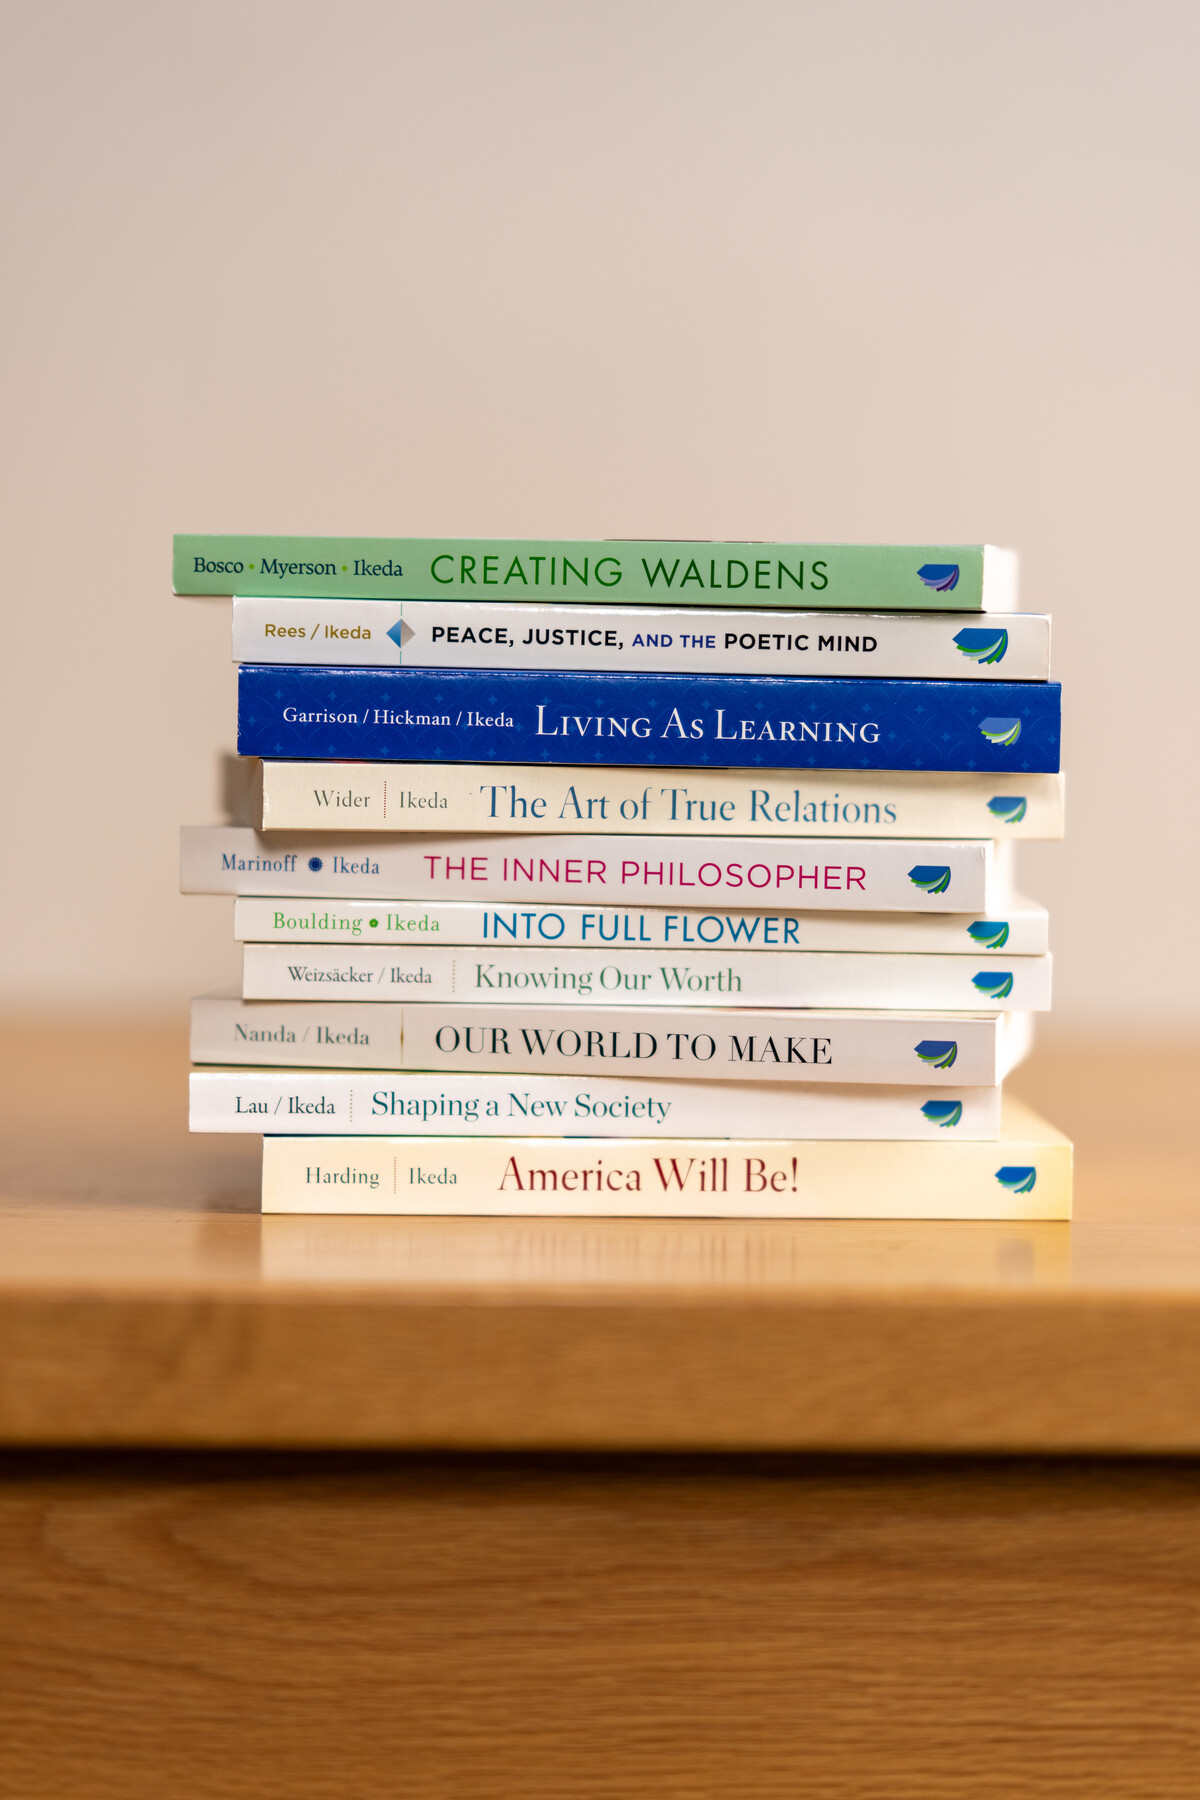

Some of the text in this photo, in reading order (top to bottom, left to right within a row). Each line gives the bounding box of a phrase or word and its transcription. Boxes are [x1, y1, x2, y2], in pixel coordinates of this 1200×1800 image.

[193, 557, 403, 579] Bosco Myerson Ikeda
[431, 554, 829, 590] CREATING WALDENS
[265, 624, 306, 638] Rees
[325, 625, 371, 640] Ikeda
[432, 627, 878, 652] PEACE, JUSTICE, AND THE POETIC MIND
[283, 707, 357, 724] Garrison
[373, 709, 451, 726] Hickman
[467, 711, 514, 727] Ikeda
[314, 789, 448, 809] Wider Ikeda
[480, 784, 897, 824] The Art of True Relations
[222, 854, 379, 874] Marinoff Ikeda
[424, 856, 866, 891] THE INNER PHILOSOPHER
[273, 912, 440, 936] Boulding Ikeda
[483, 912, 800, 944] INTO FULL FLOWER
[288, 966, 373, 983] Weizsäcker
[390, 967, 432, 984] Ikeda
[474, 964, 742, 994] Knowing Our Worth
[234, 1024, 296, 1043] Nanda
[316, 1026, 369, 1045] Ikeda
[435, 1026, 832, 1064] OUR WORLD TO MAKE
[235, 1096, 268, 1114] Lau
[288, 1096, 335, 1114] Ikeda
[372, 1091, 671, 1124] Shaping a New Society
[306, 1167, 457, 1189] Harding Ikeda
[497, 1156, 798, 1192] America Will Be!
